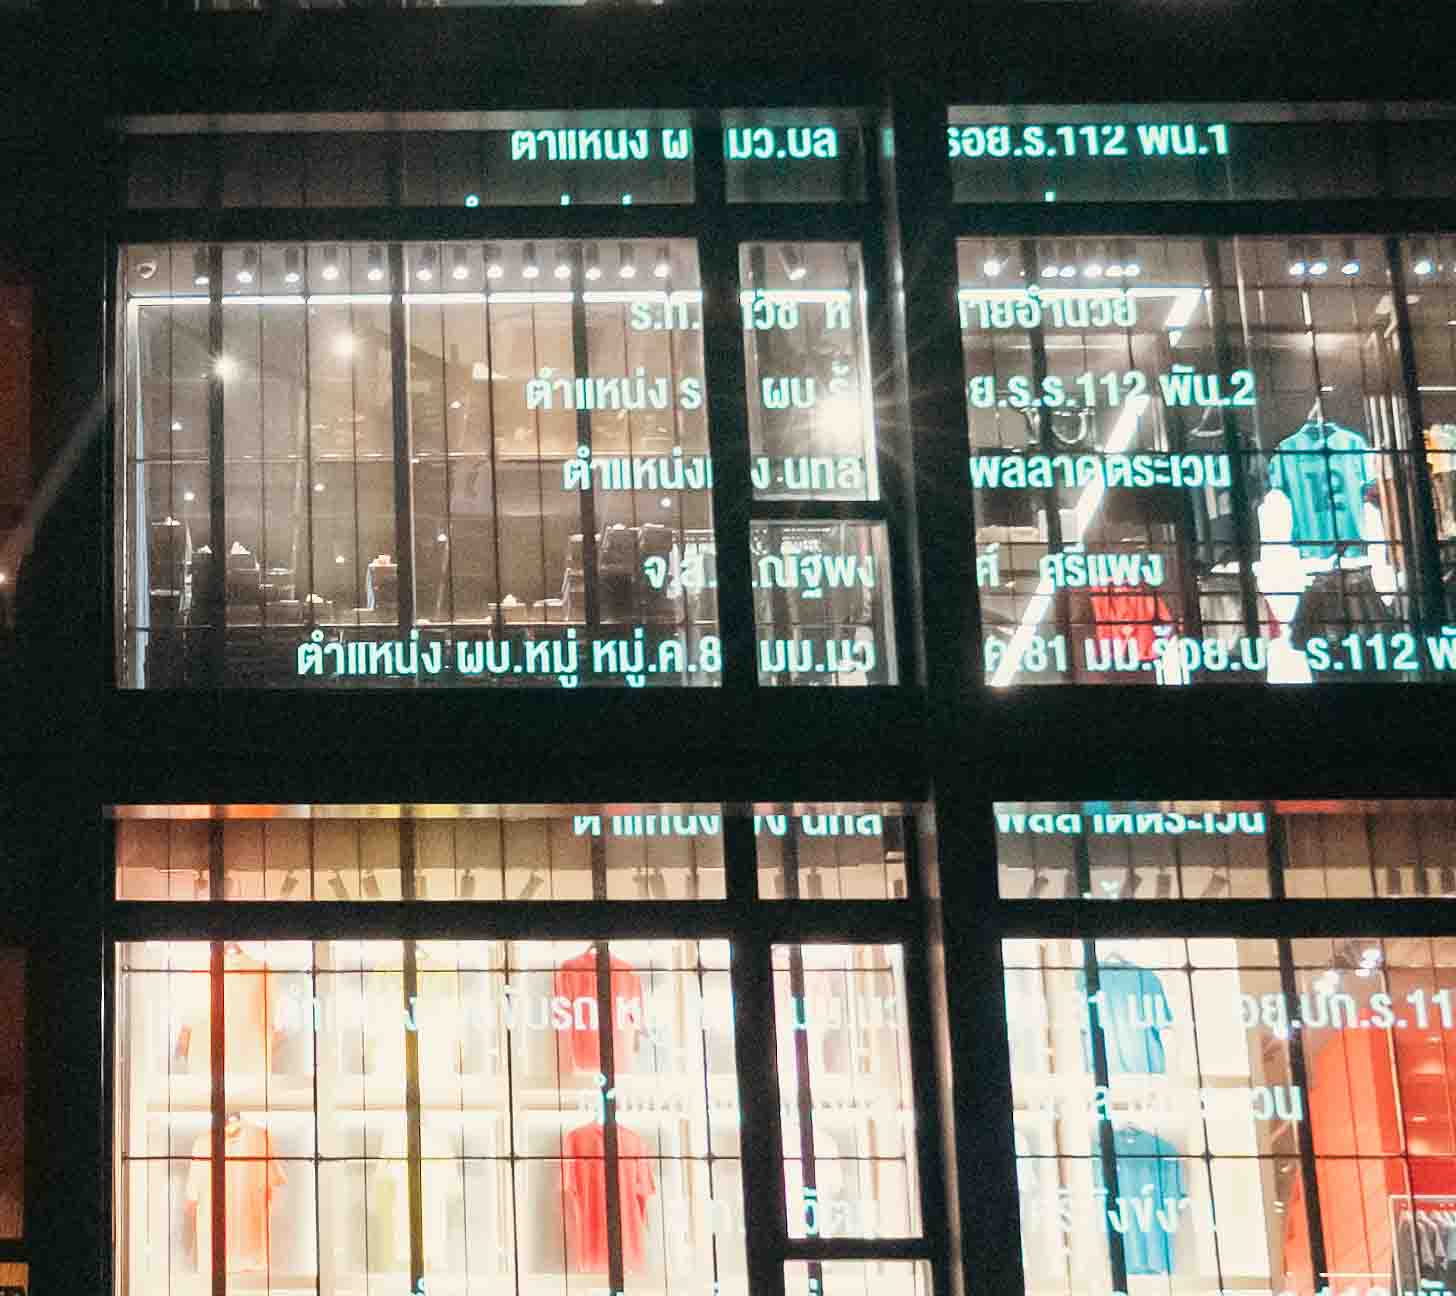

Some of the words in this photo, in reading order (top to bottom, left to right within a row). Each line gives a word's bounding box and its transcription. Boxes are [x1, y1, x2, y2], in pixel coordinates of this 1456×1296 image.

[297, 629, 441, 674] ตำแหน่ง
[456, 628, 578, 688] ผบ.หมู่
